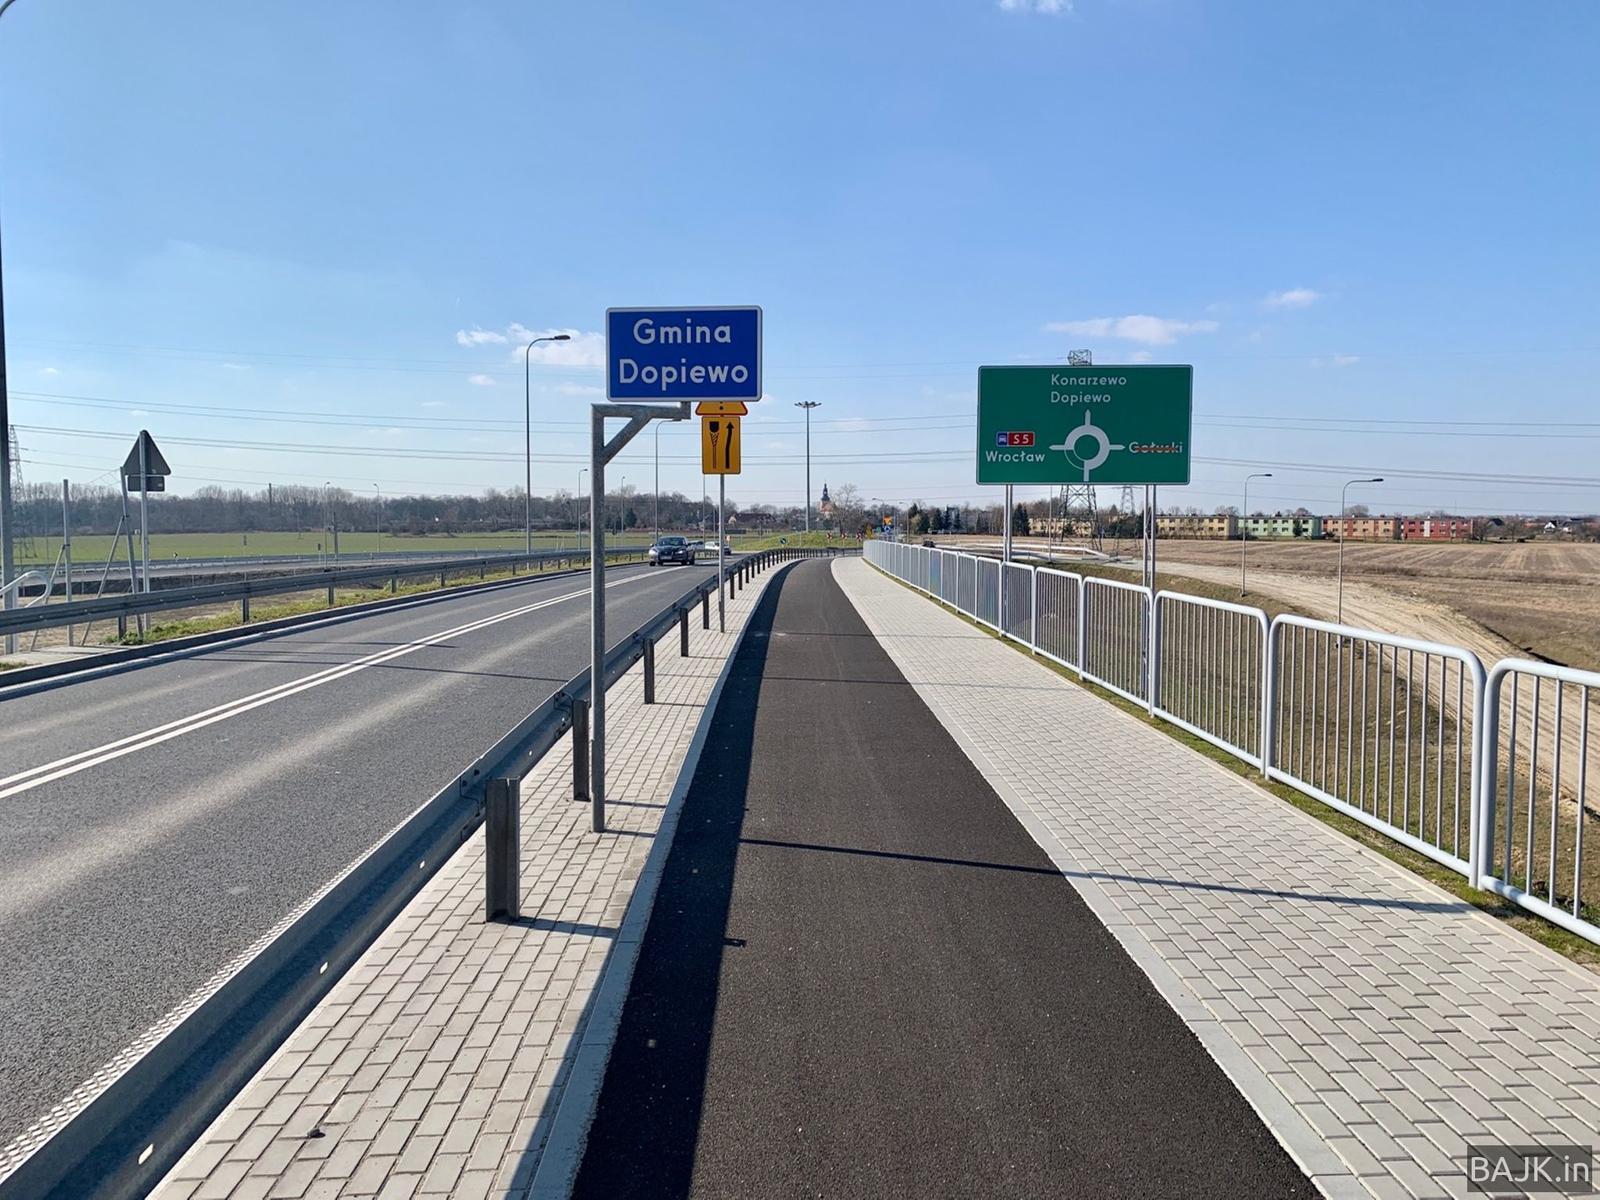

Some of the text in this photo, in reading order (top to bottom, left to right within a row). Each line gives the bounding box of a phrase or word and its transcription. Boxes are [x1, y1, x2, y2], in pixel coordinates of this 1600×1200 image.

[633, 318, 732, 345] Gmina
[619, 358, 749, 391] Dopiewo
[1051, 374, 1127, 386] Konarzewo
[1050, 391, 1111, 406] Dopiewo
[985, 451, 1045, 463] Wrocław
